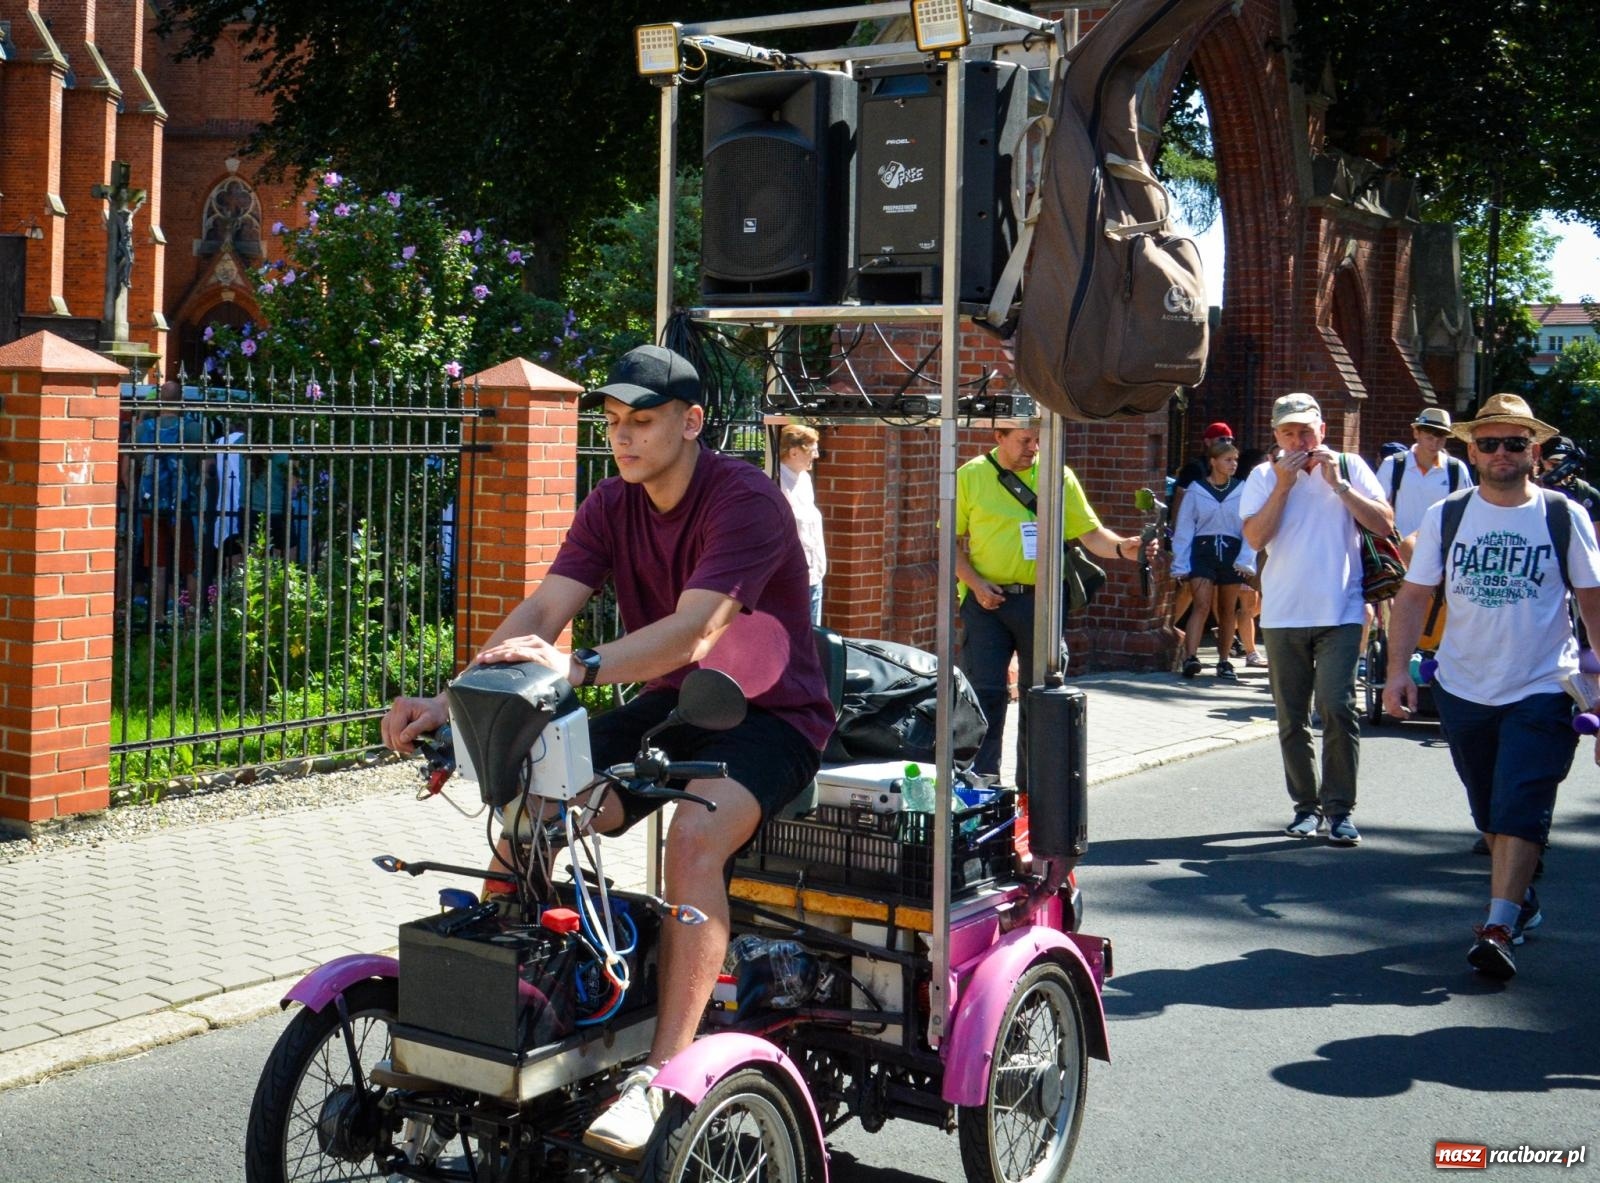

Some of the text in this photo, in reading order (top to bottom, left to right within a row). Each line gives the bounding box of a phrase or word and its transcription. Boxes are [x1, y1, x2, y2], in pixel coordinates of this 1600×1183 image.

[1476, 534, 1528, 546] VACATION
[1451, 541, 1552, 587] PACIFIC
[1483, 575, 1508, 587] 096
